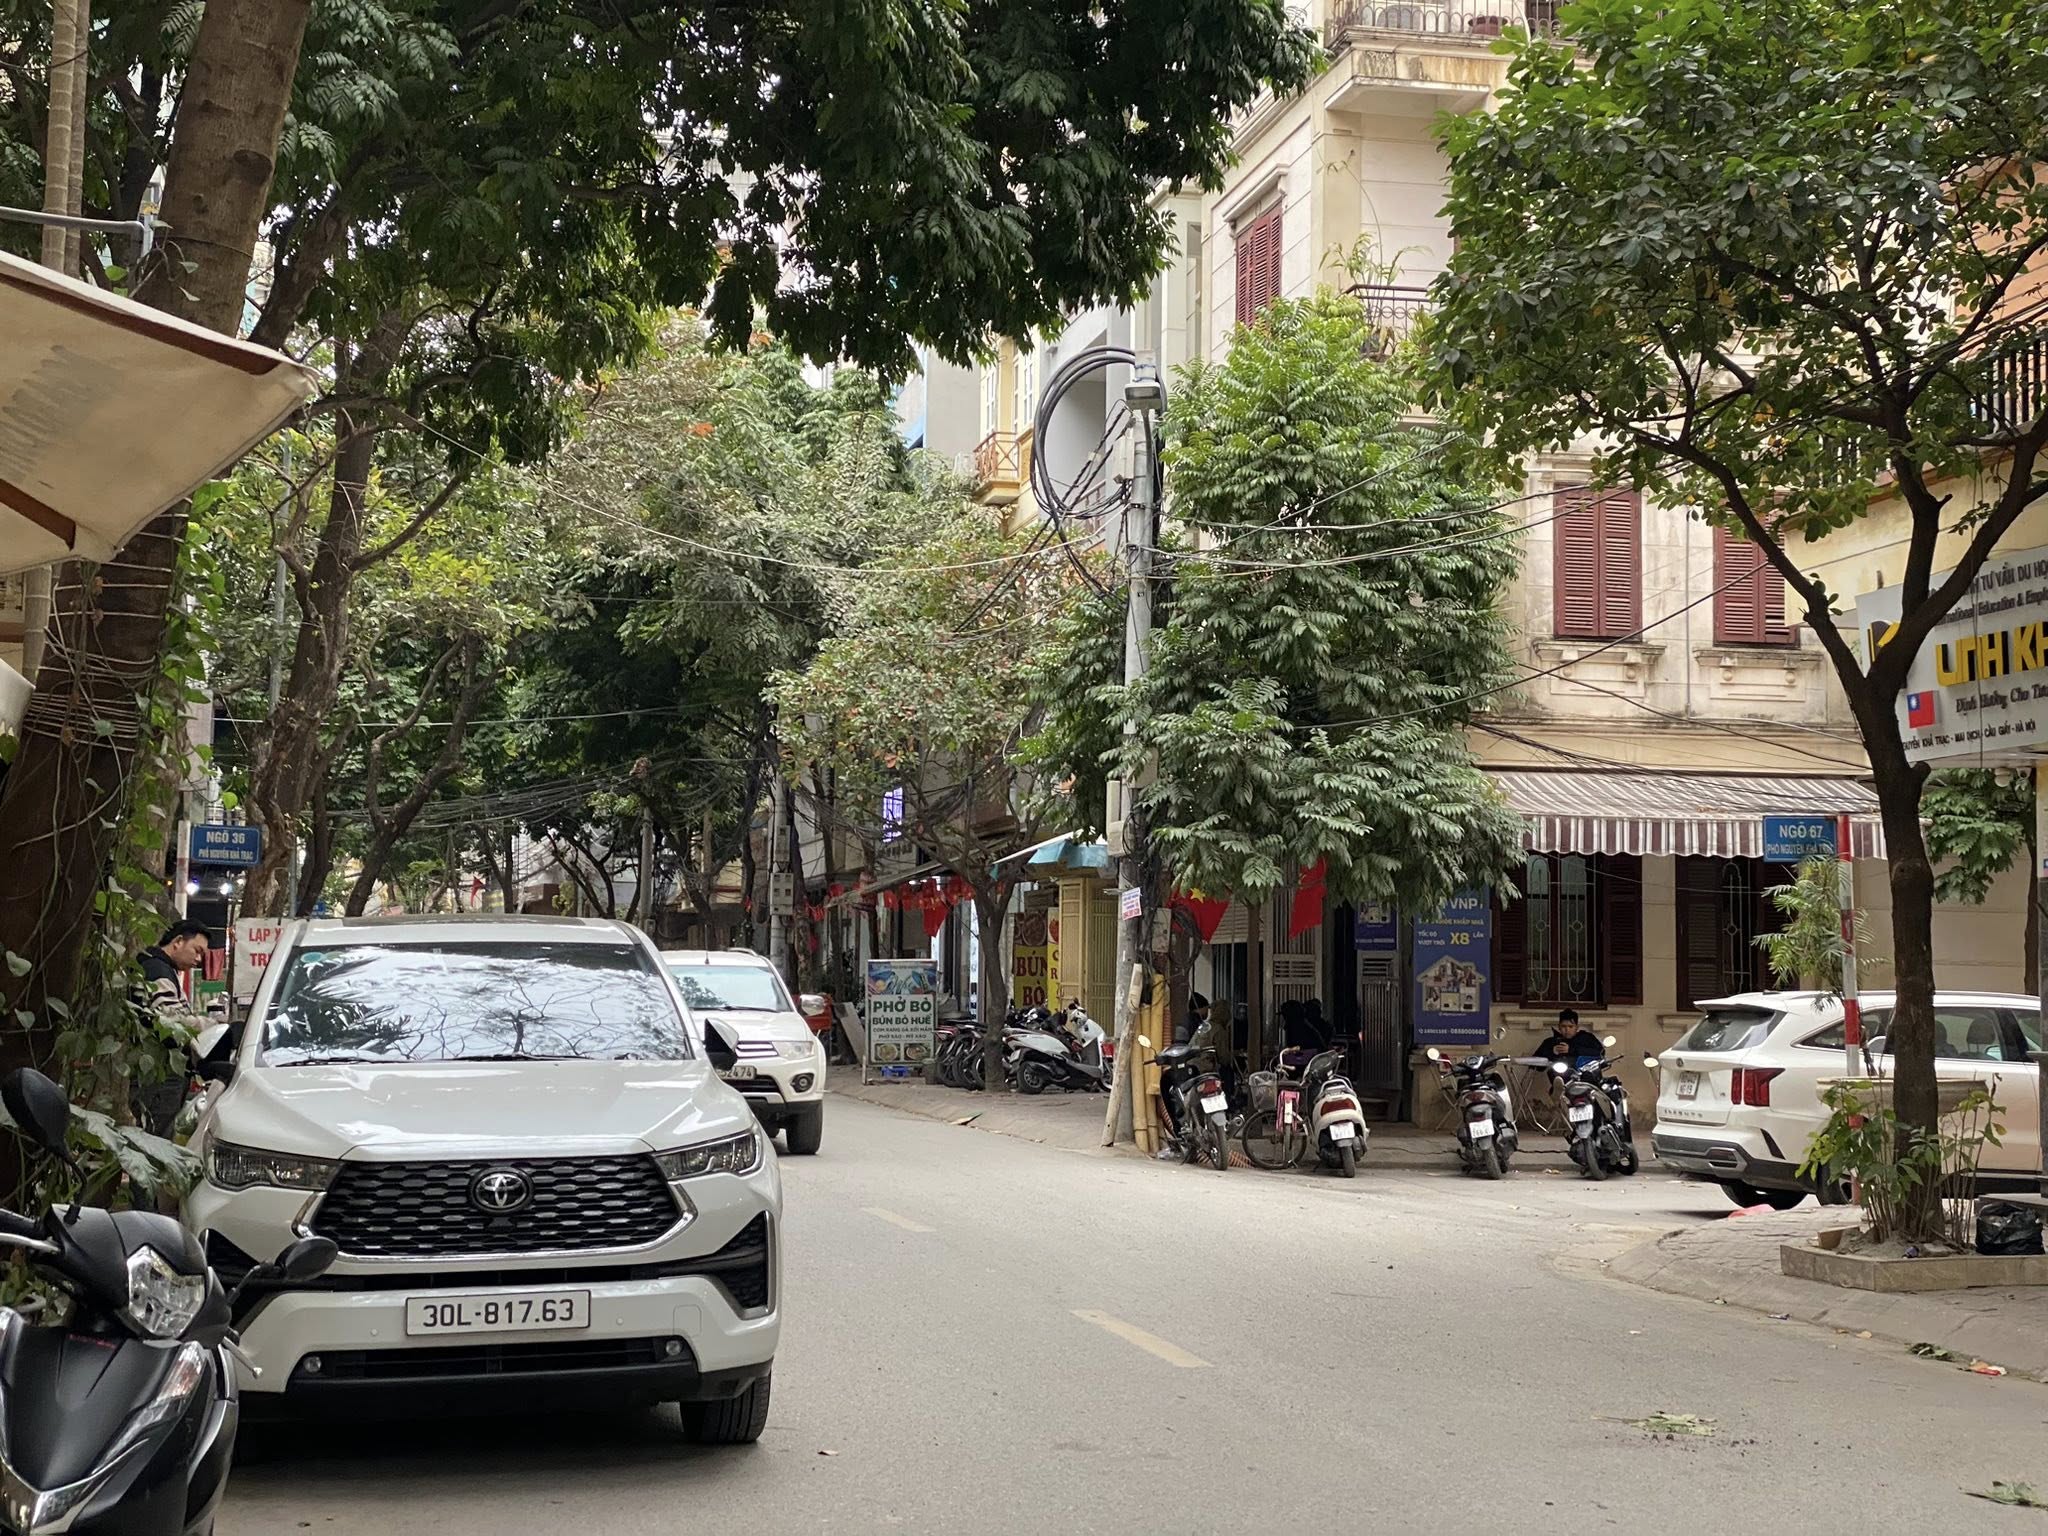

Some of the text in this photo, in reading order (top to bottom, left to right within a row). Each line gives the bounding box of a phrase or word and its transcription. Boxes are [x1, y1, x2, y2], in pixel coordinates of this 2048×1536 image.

[2017, 563, 2031, 582] DU
[2010, 687, 2029, 702] Cho
[2015, 719, 2025, 733] HÀ
[206, 829, 245, 844] NGÕ 36
[1779, 821, 1823, 839] NGÕ 67
[1450, 931, 1470, 945] X8
[1016, 950, 1048, 977] BÚN
[1023, 980, 1046, 1007] BÒ
[873, 996, 932, 1013] PHỞ BÒ
[872, 1013, 932, 1025] BÚN BÒ HUẾ
[422, 1298, 575, 1328] 30L-817.63
